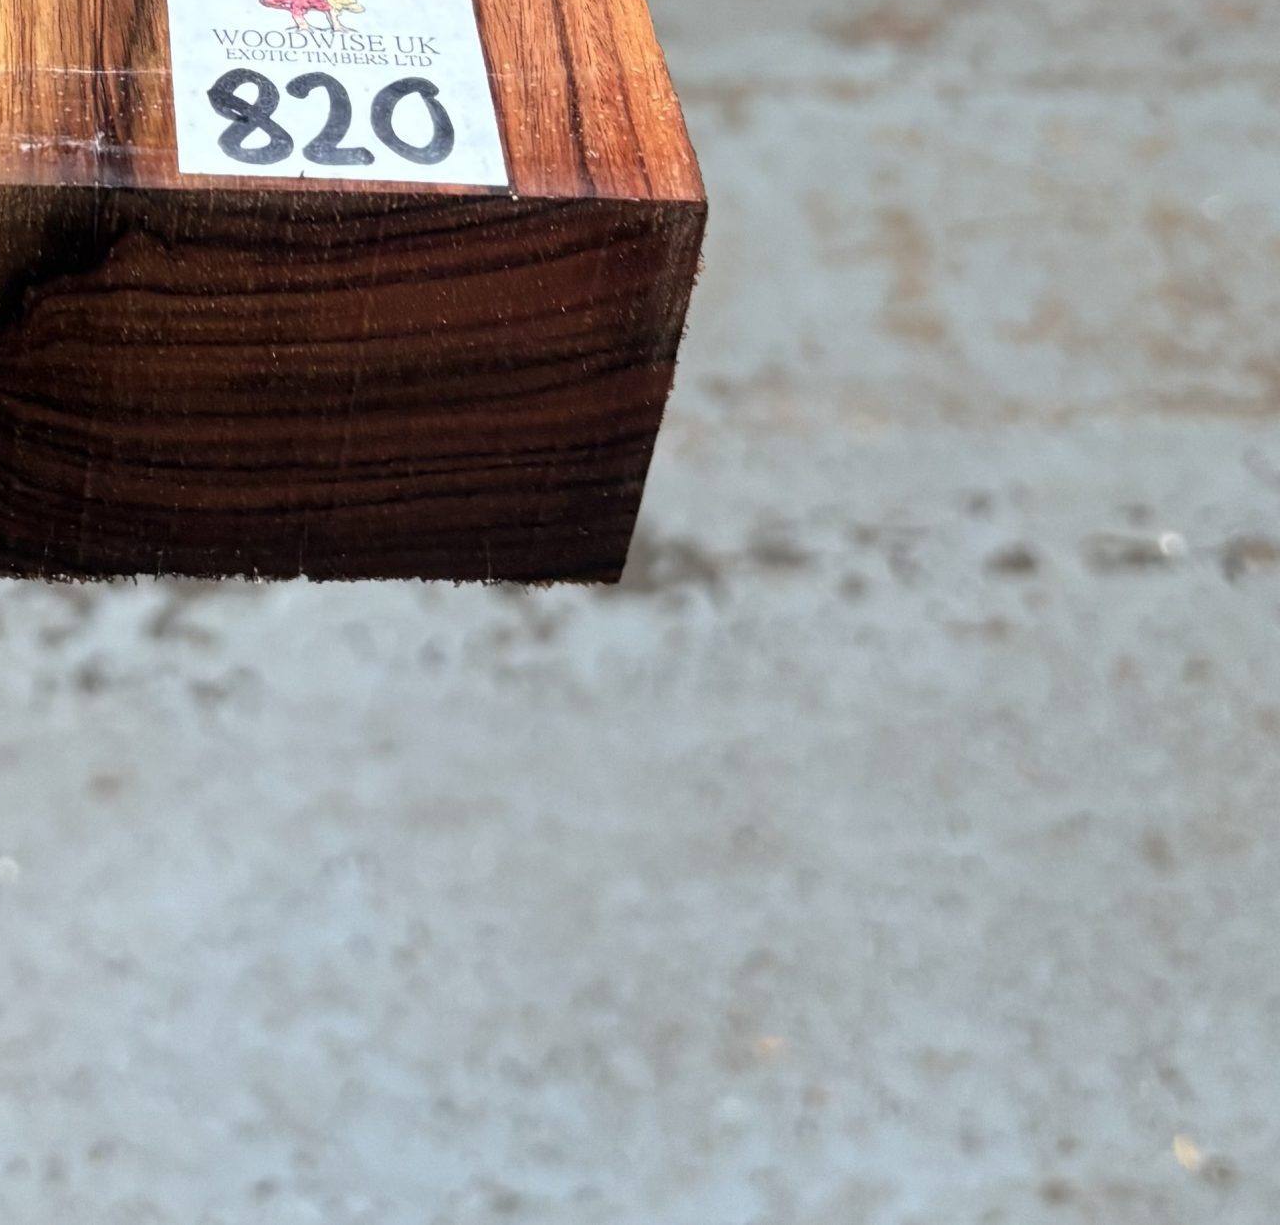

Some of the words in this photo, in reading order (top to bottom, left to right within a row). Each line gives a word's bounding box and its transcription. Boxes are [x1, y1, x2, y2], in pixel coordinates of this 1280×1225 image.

[212, 28, 384, 52] WOODWISE
[396, 35, 441, 55] UK
[226, 48, 298, 62] EXOTIC
[304, 50, 390, 66] TIMBERS
[394, 54, 433, 67] LTD
[206, 67, 455, 166] 820
